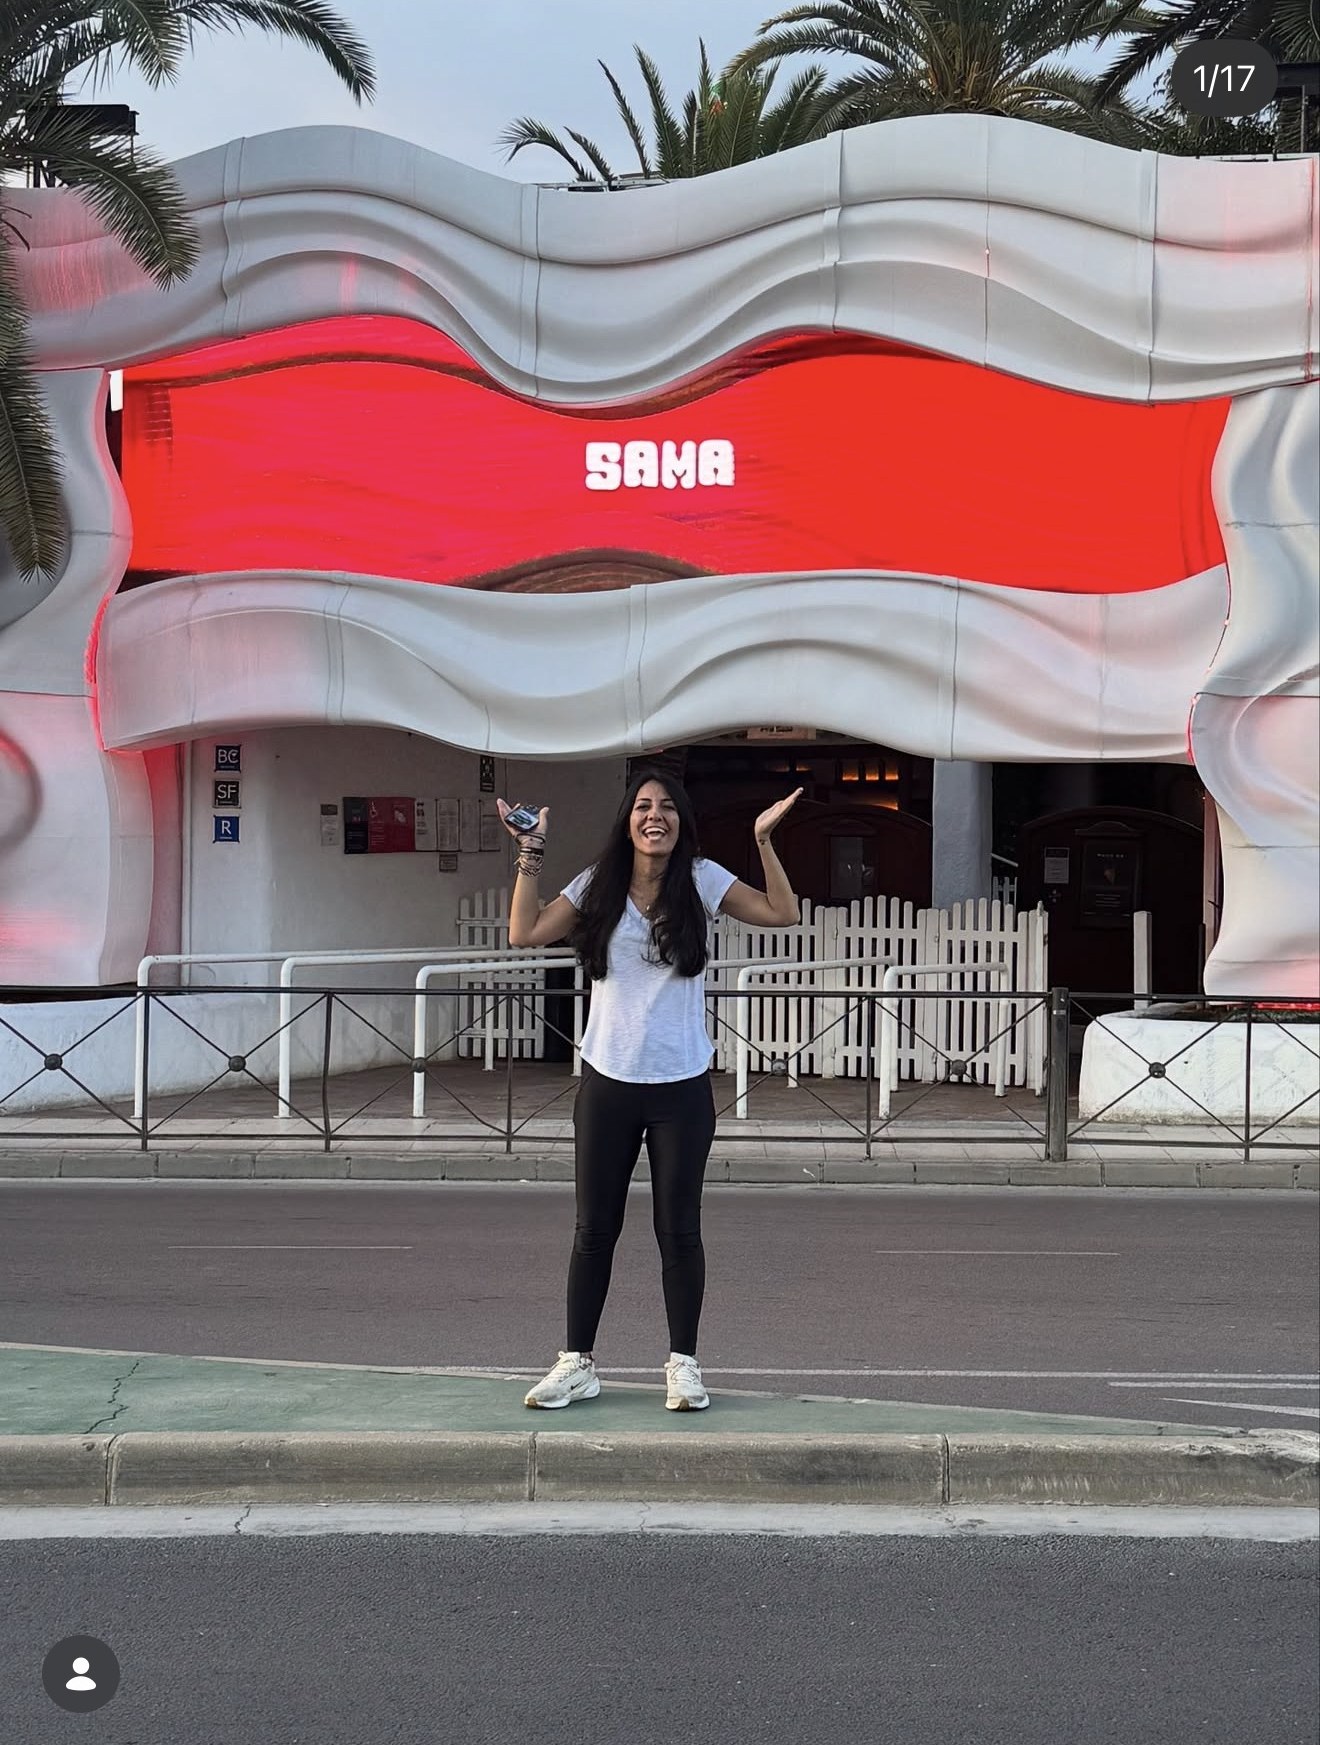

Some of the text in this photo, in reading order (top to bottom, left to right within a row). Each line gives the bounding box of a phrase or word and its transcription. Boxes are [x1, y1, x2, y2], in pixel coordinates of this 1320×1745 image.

[585, 439, 735, 490] SAMA
[217, 784, 237, 799] SF
[221, 820, 232, 835] R
